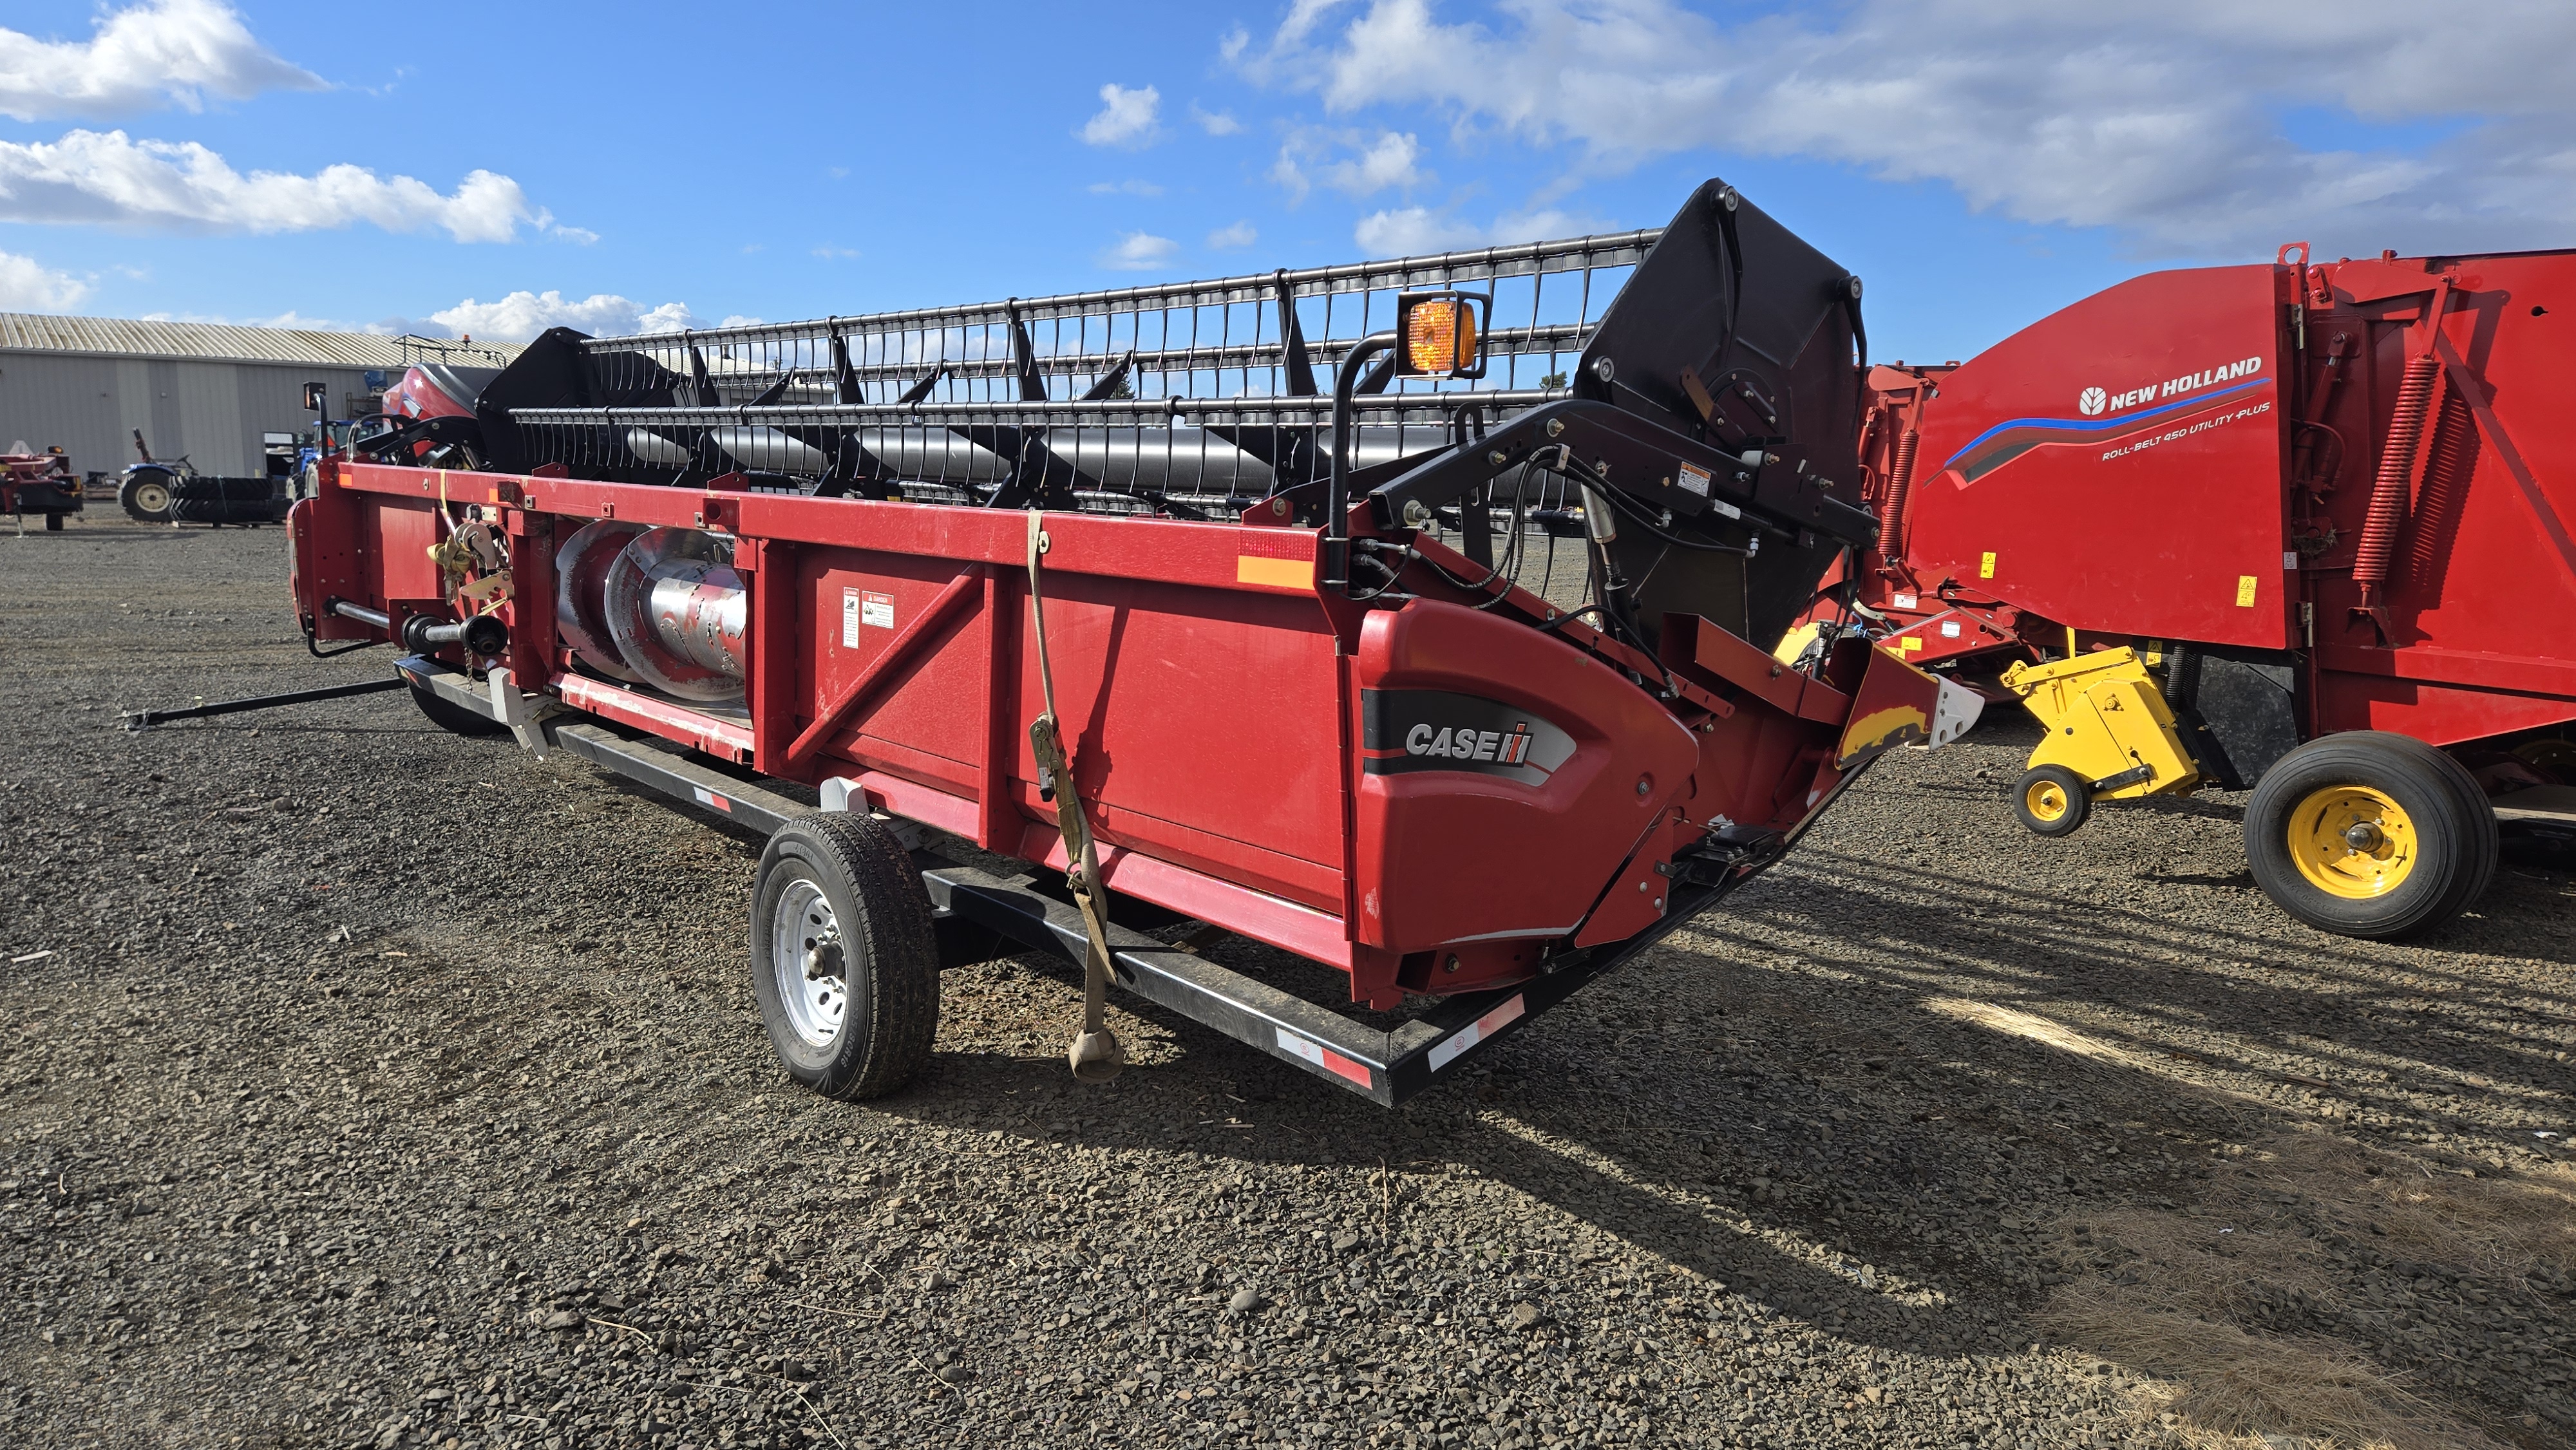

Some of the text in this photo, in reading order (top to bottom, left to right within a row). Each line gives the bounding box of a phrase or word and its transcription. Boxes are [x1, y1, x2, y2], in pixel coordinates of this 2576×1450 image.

[2110, 356, 2262, 411] NEW HOLLAND
[2102, 436, 2161, 461] ROLL-BELT
[2190, 413, 2234, 434] UTILITY
[1406, 723, 1501, 760] CASE
